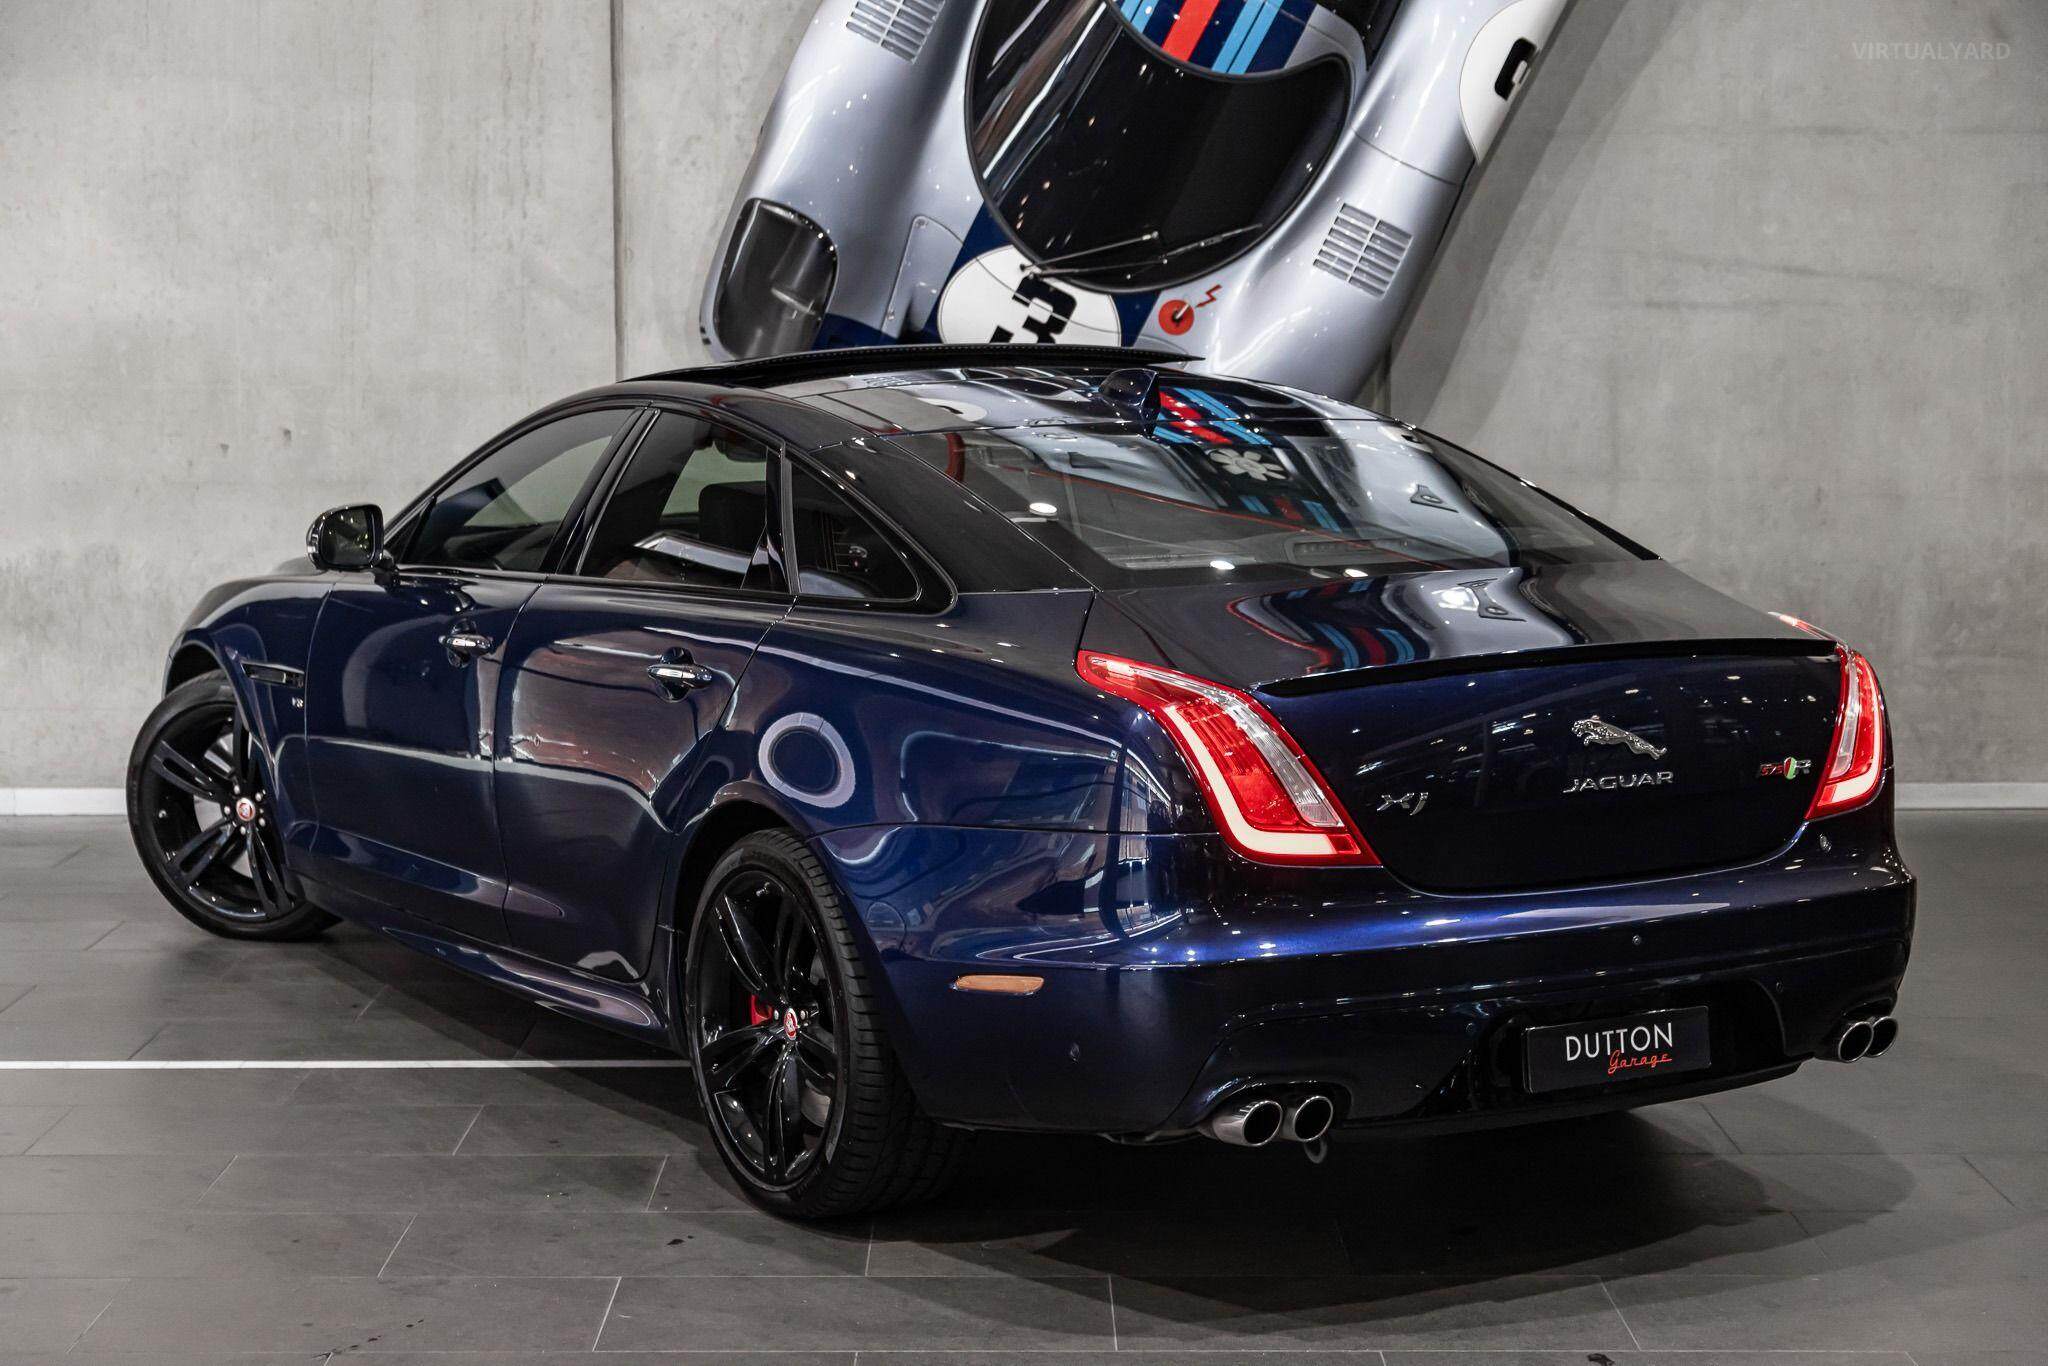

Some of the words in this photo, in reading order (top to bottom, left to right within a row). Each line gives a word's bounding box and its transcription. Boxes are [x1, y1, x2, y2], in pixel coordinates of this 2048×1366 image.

[1562, 771, 1674, 793] JAGUAR
[1376, 792, 1429, 816] XJ
[1565, 1022, 1673, 1062] DUTTON
[1607, 1049, 1673, 1076] Garage
